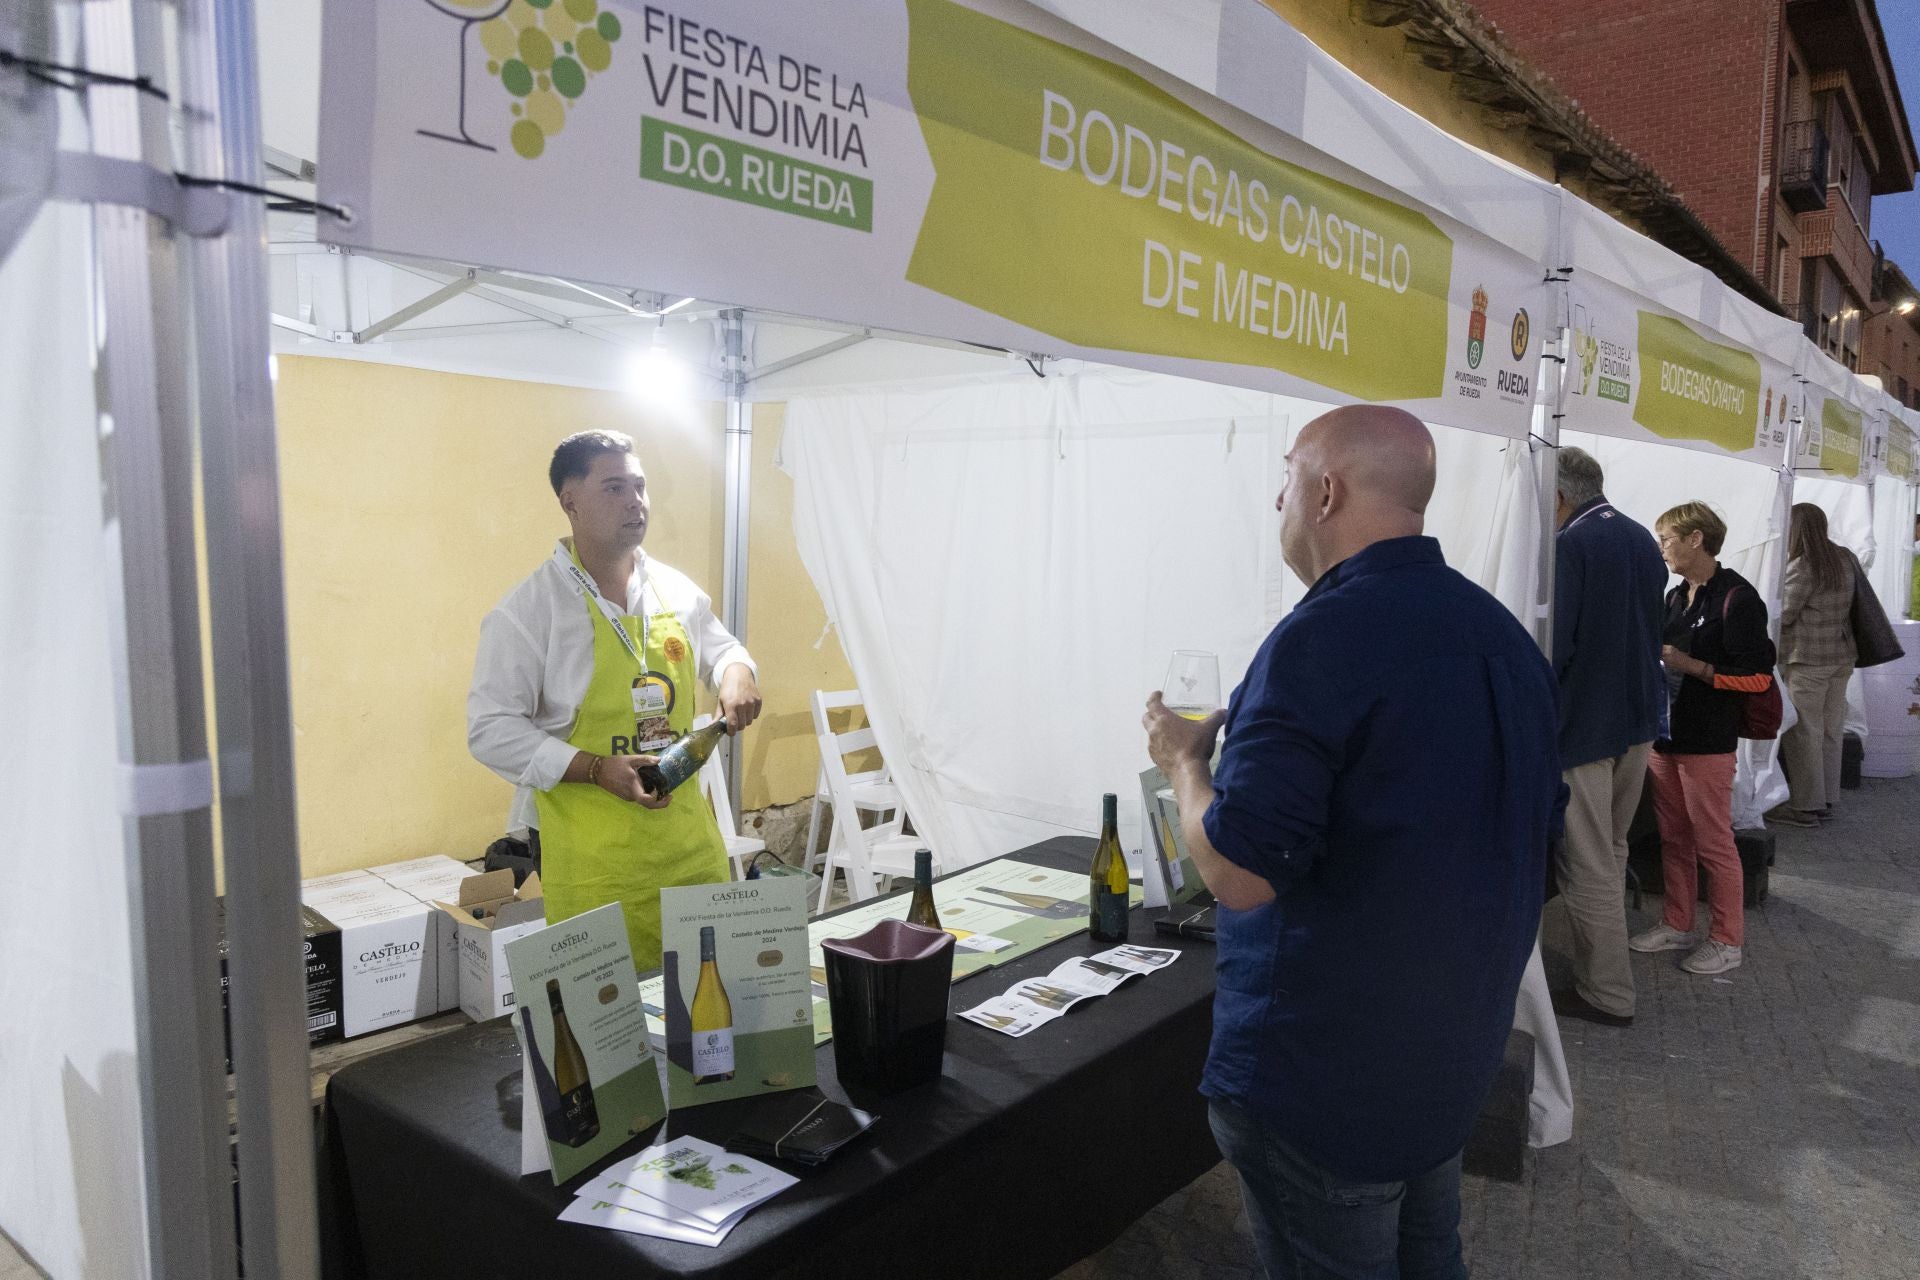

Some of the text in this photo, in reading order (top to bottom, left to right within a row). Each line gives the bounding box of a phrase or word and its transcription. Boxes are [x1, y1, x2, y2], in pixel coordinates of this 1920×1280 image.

[644, 5, 868, 118] FIESTA DE LA
[642, 53, 868, 168] VENDIMIA
[663, 131, 856, 218] D.O. RUEDA
[1039, 88, 1411, 294] BODEGAS CASTELO
[1142, 239, 1349, 355] DE MEDINA
[1454, 371, 1488, 387] AYUNTAMIENTO
[1599, 356, 1630, 380] VENDIMIA
[1459, 386, 1481, 399] DE RUEDA
[1497, 369, 1529, 397] RUEDA
[1610, 382, 1627, 399] RUEDA
[1660, 360, 1745, 416] BODEGAS CYATHO
[712, 889, 759, 902] CASTELO
[698, 912, 716, 921] Fiesta
[773, 905, 792, 913] Rueda
[551, 931, 589, 953] CASTELO
[731, 925, 806, 939] Castelo de Medina Verdejo
[762, 936, 777, 944] 2024
[359, 941, 420, 963] CASTELO
